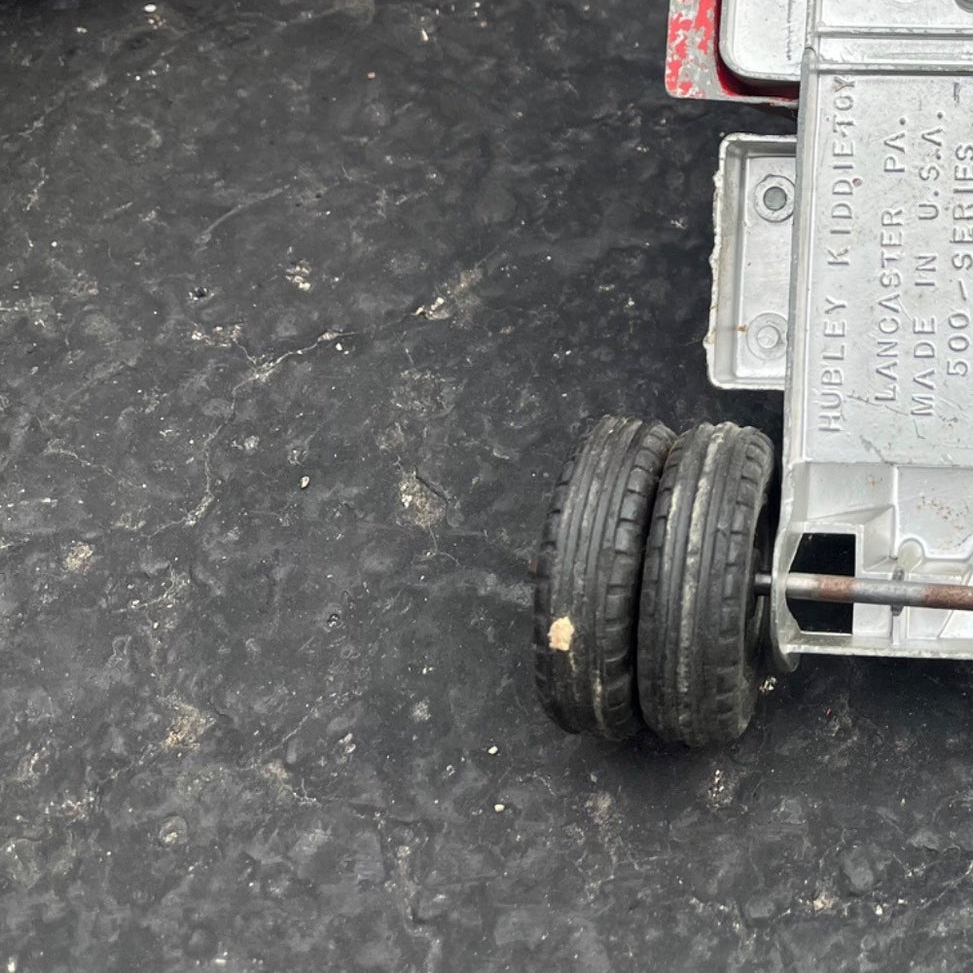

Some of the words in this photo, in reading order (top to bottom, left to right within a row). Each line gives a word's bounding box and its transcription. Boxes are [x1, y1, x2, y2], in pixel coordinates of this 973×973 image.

[825, 75, 857, 266] KIDDIETOY
[882, 114, 907, 174] PA.
[917, 110, 944, 221] U.S.A.
[874, 207, 905, 402] LANCASTER
[914, 253, 937, 288] IN
[817, 295, 848, 434] HUBLEY
[910, 314, 936, 418] MADE
